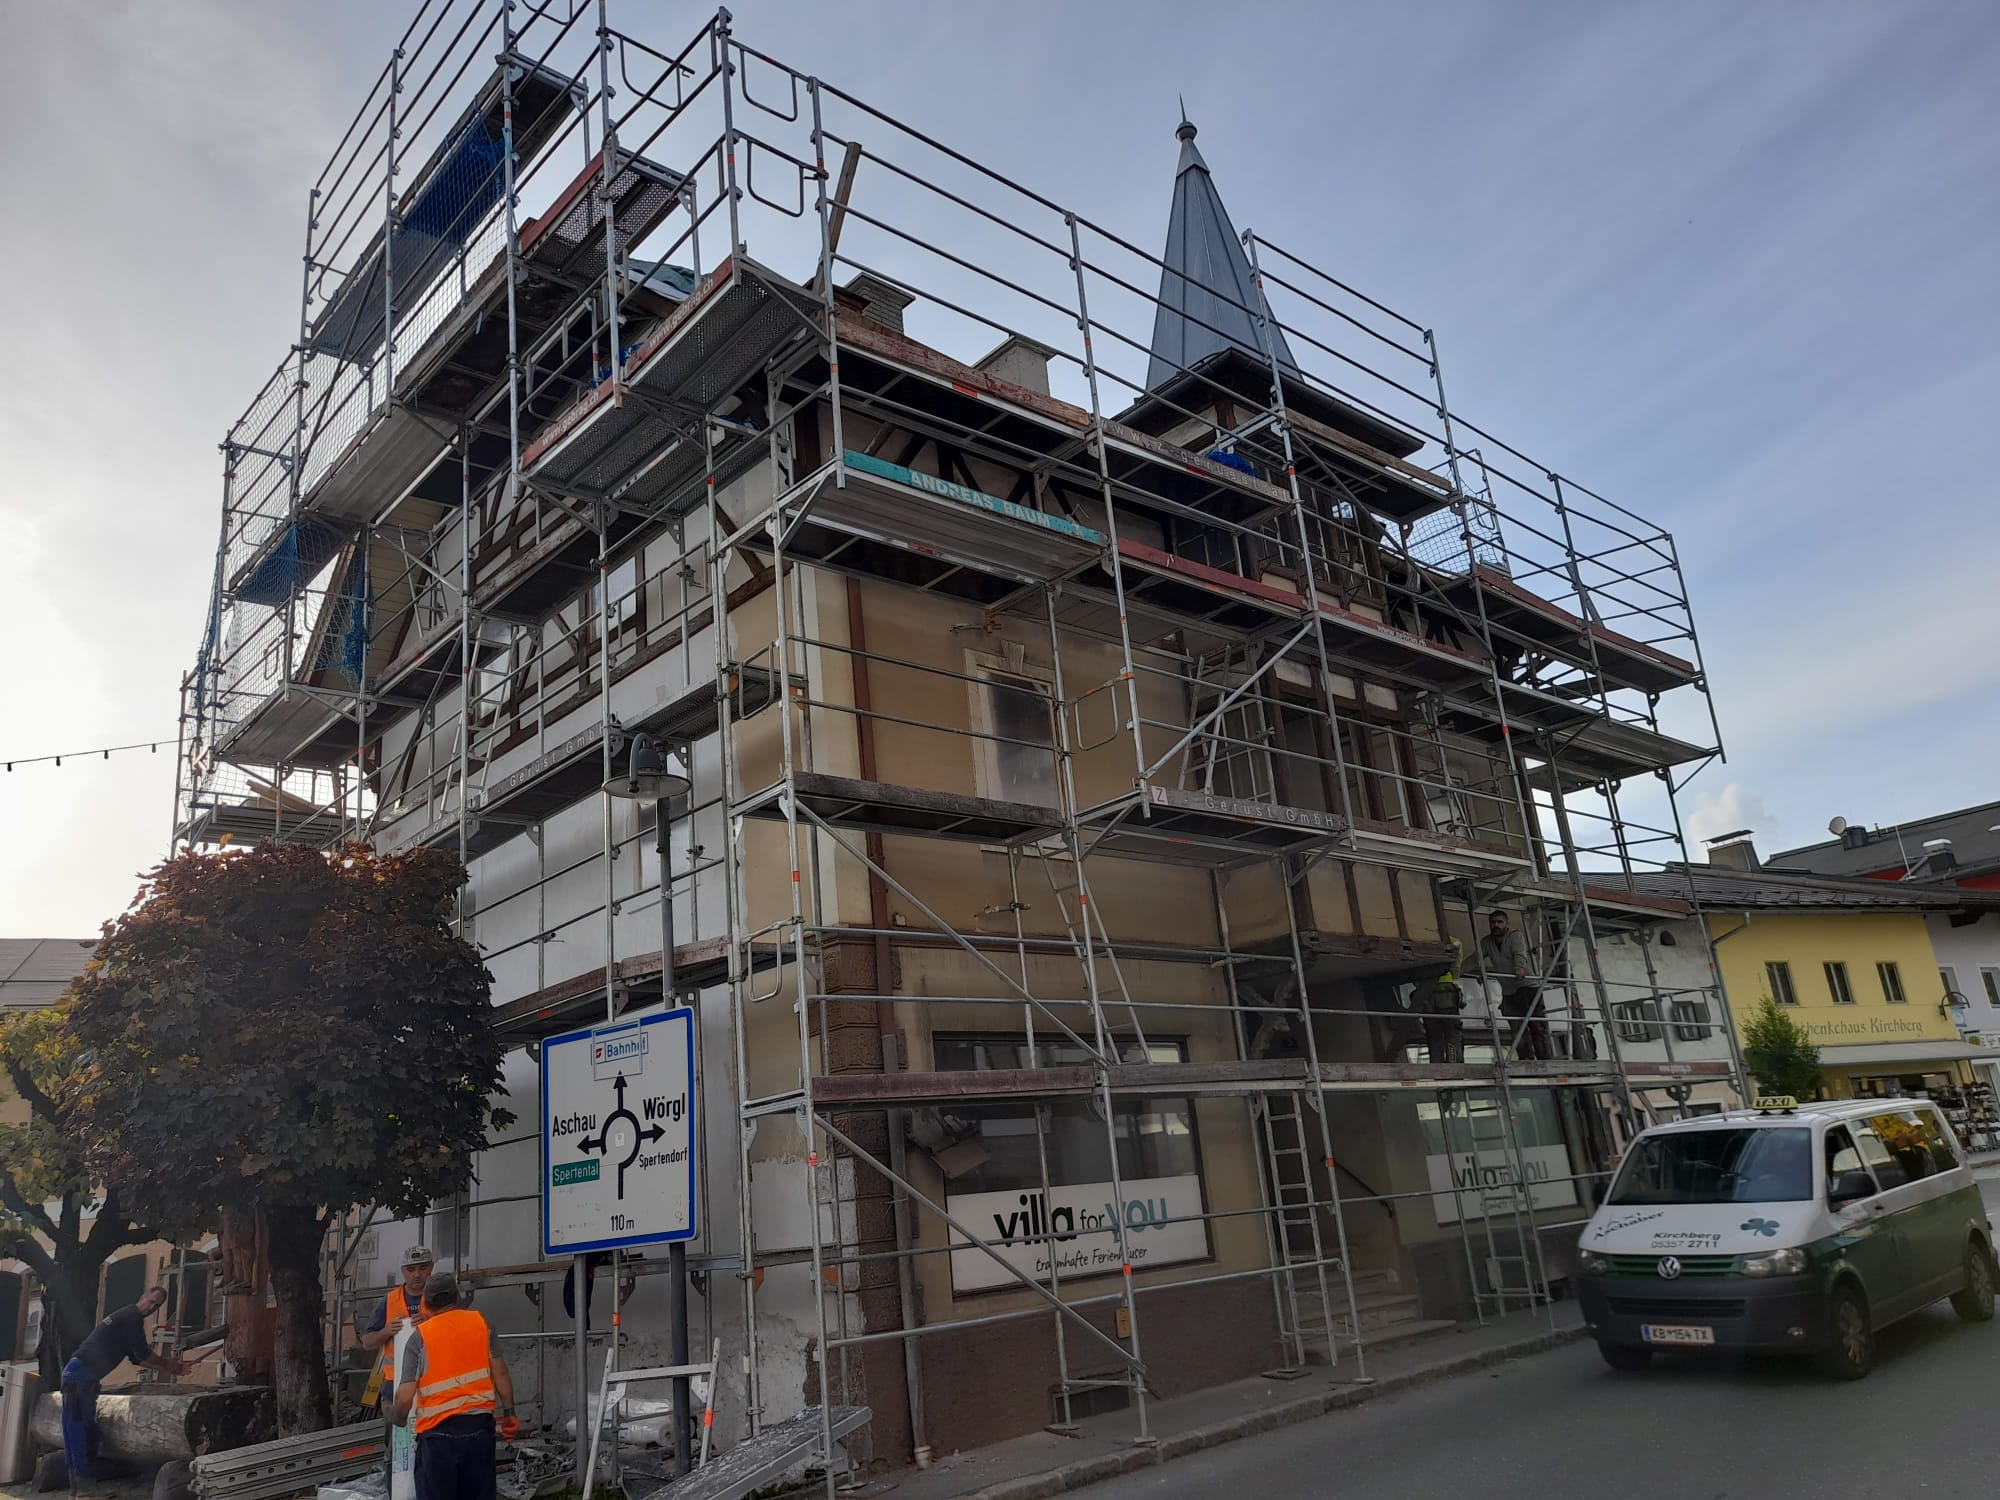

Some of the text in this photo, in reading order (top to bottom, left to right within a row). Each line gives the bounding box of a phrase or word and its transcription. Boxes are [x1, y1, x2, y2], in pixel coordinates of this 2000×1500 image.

[910, 471, 1051, 528] ANDREAS BAUM
[1286, 809, 1333, 827] GmbH
[1870, 1017, 1923, 1034] Kirchberg
[643, 1092, 686, 1121] Wörgl
[1756, 1097, 1790, 1108] TAXI
[552, 1112, 597, 1137] Aschau
[638, 1148, 689, 1170] Spertendorf
[553, 1161, 600, 1184] Spertental
[610, 1214, 625, 1232] 110
[993, 1193, 1077, 1248] villa
[1080, 1208, 1106, 1232] for
[1653, 1231, 1721, 1241] Kirchberg
[1687, 1239, 1718, 1248] 2711
[1036, 1247, 1148, 1272] tramhafte Ferienhuser
